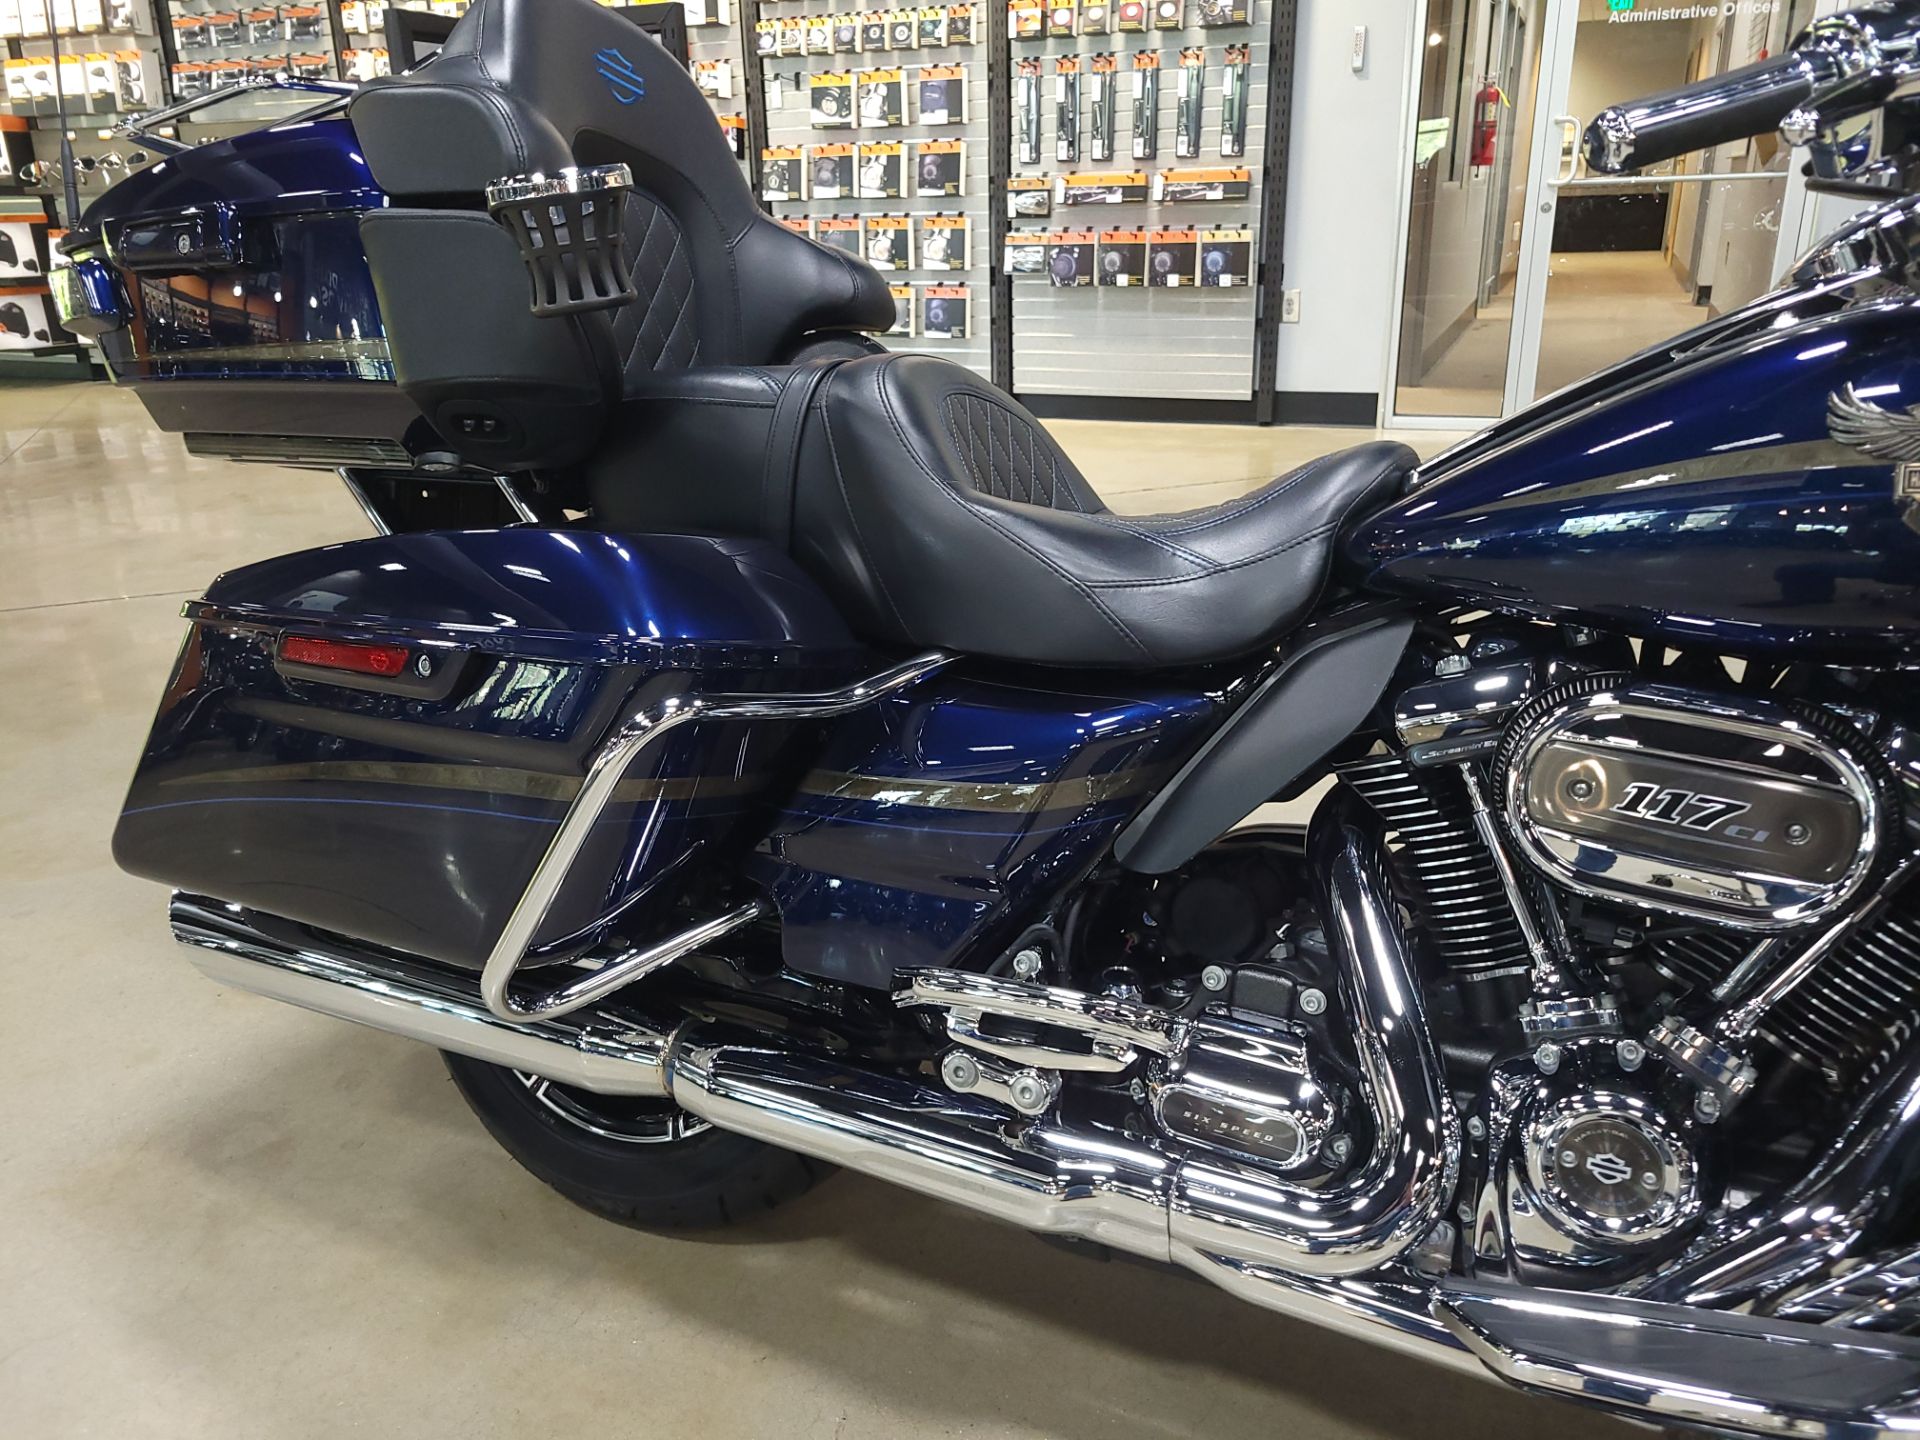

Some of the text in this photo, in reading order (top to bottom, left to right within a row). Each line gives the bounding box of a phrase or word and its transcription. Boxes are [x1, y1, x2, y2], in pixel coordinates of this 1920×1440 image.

[1608, 1, 1781, 24] Administrative Offices
[1610, 782, 1770, 843] 117 CI
[1183, 1110, 1274, 1142] SIX SPEED
